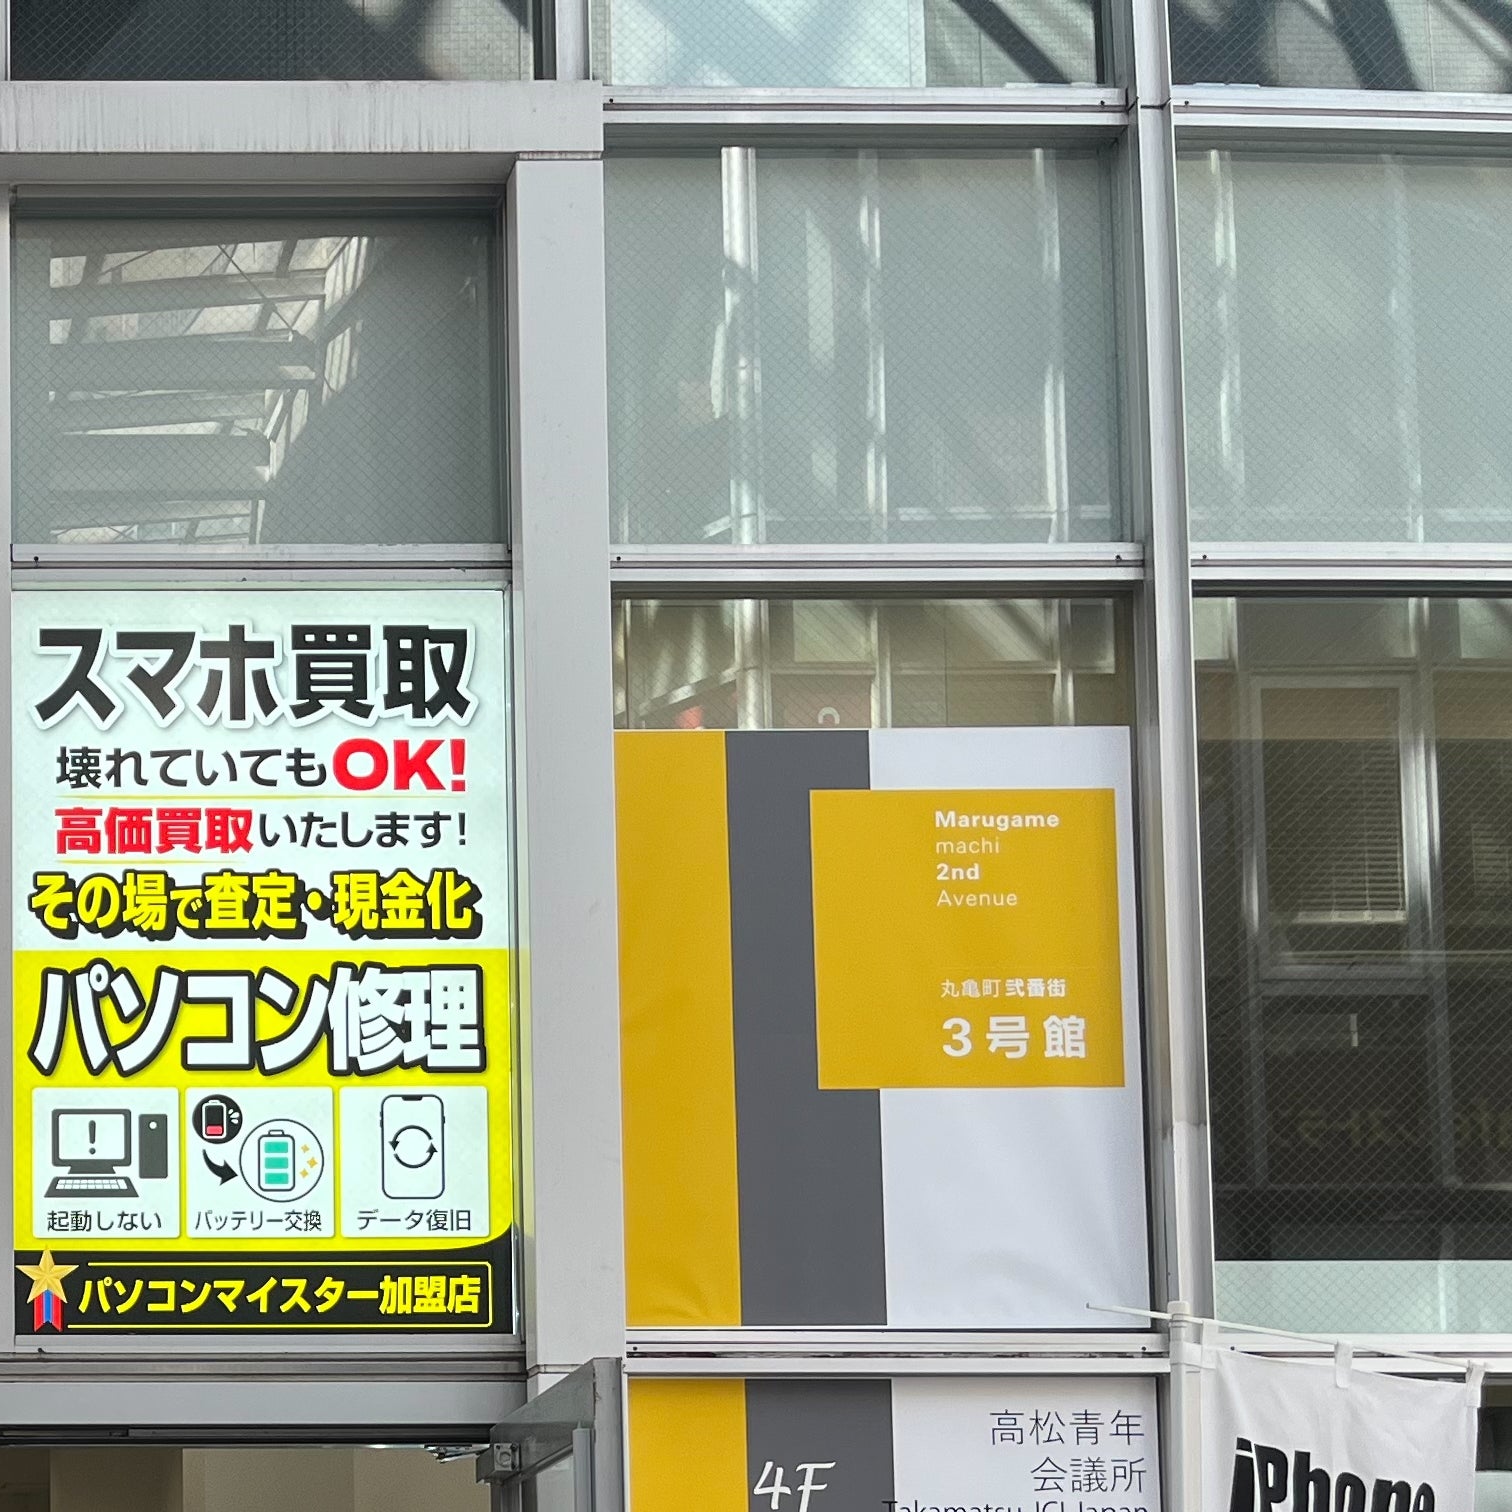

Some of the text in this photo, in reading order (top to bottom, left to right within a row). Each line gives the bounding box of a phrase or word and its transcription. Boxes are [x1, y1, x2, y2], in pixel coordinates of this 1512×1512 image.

[34, 623, 472, 722] スマホ買取
[55, 738, 467, 792] 壊れていてもOK!
[53, 806, 467, 855] 高価買取いたします!
[934, 810, 1060, 832] Marugame
[935, 836, 1001, 854] machi
[936, 863, 981, 881] 2nd
[31, 871, 474, 932] その場で査定・現金化
[936, 889, 1018, 907] Avenue
[32, 962, 481, 1072] パソコン修理
[45, 1209, 163, 1233] 起動しない
[193, 1209, 323, 1233] バッテリー交換
[357, 1207, 472, 1232] データ復旧
[78, 1275, 482, 1315] パソコンマイスター加盟店
[989, 1408, 1145, 1447] 高松青年
[1030, 1456, 1147, 1495] 会議所
